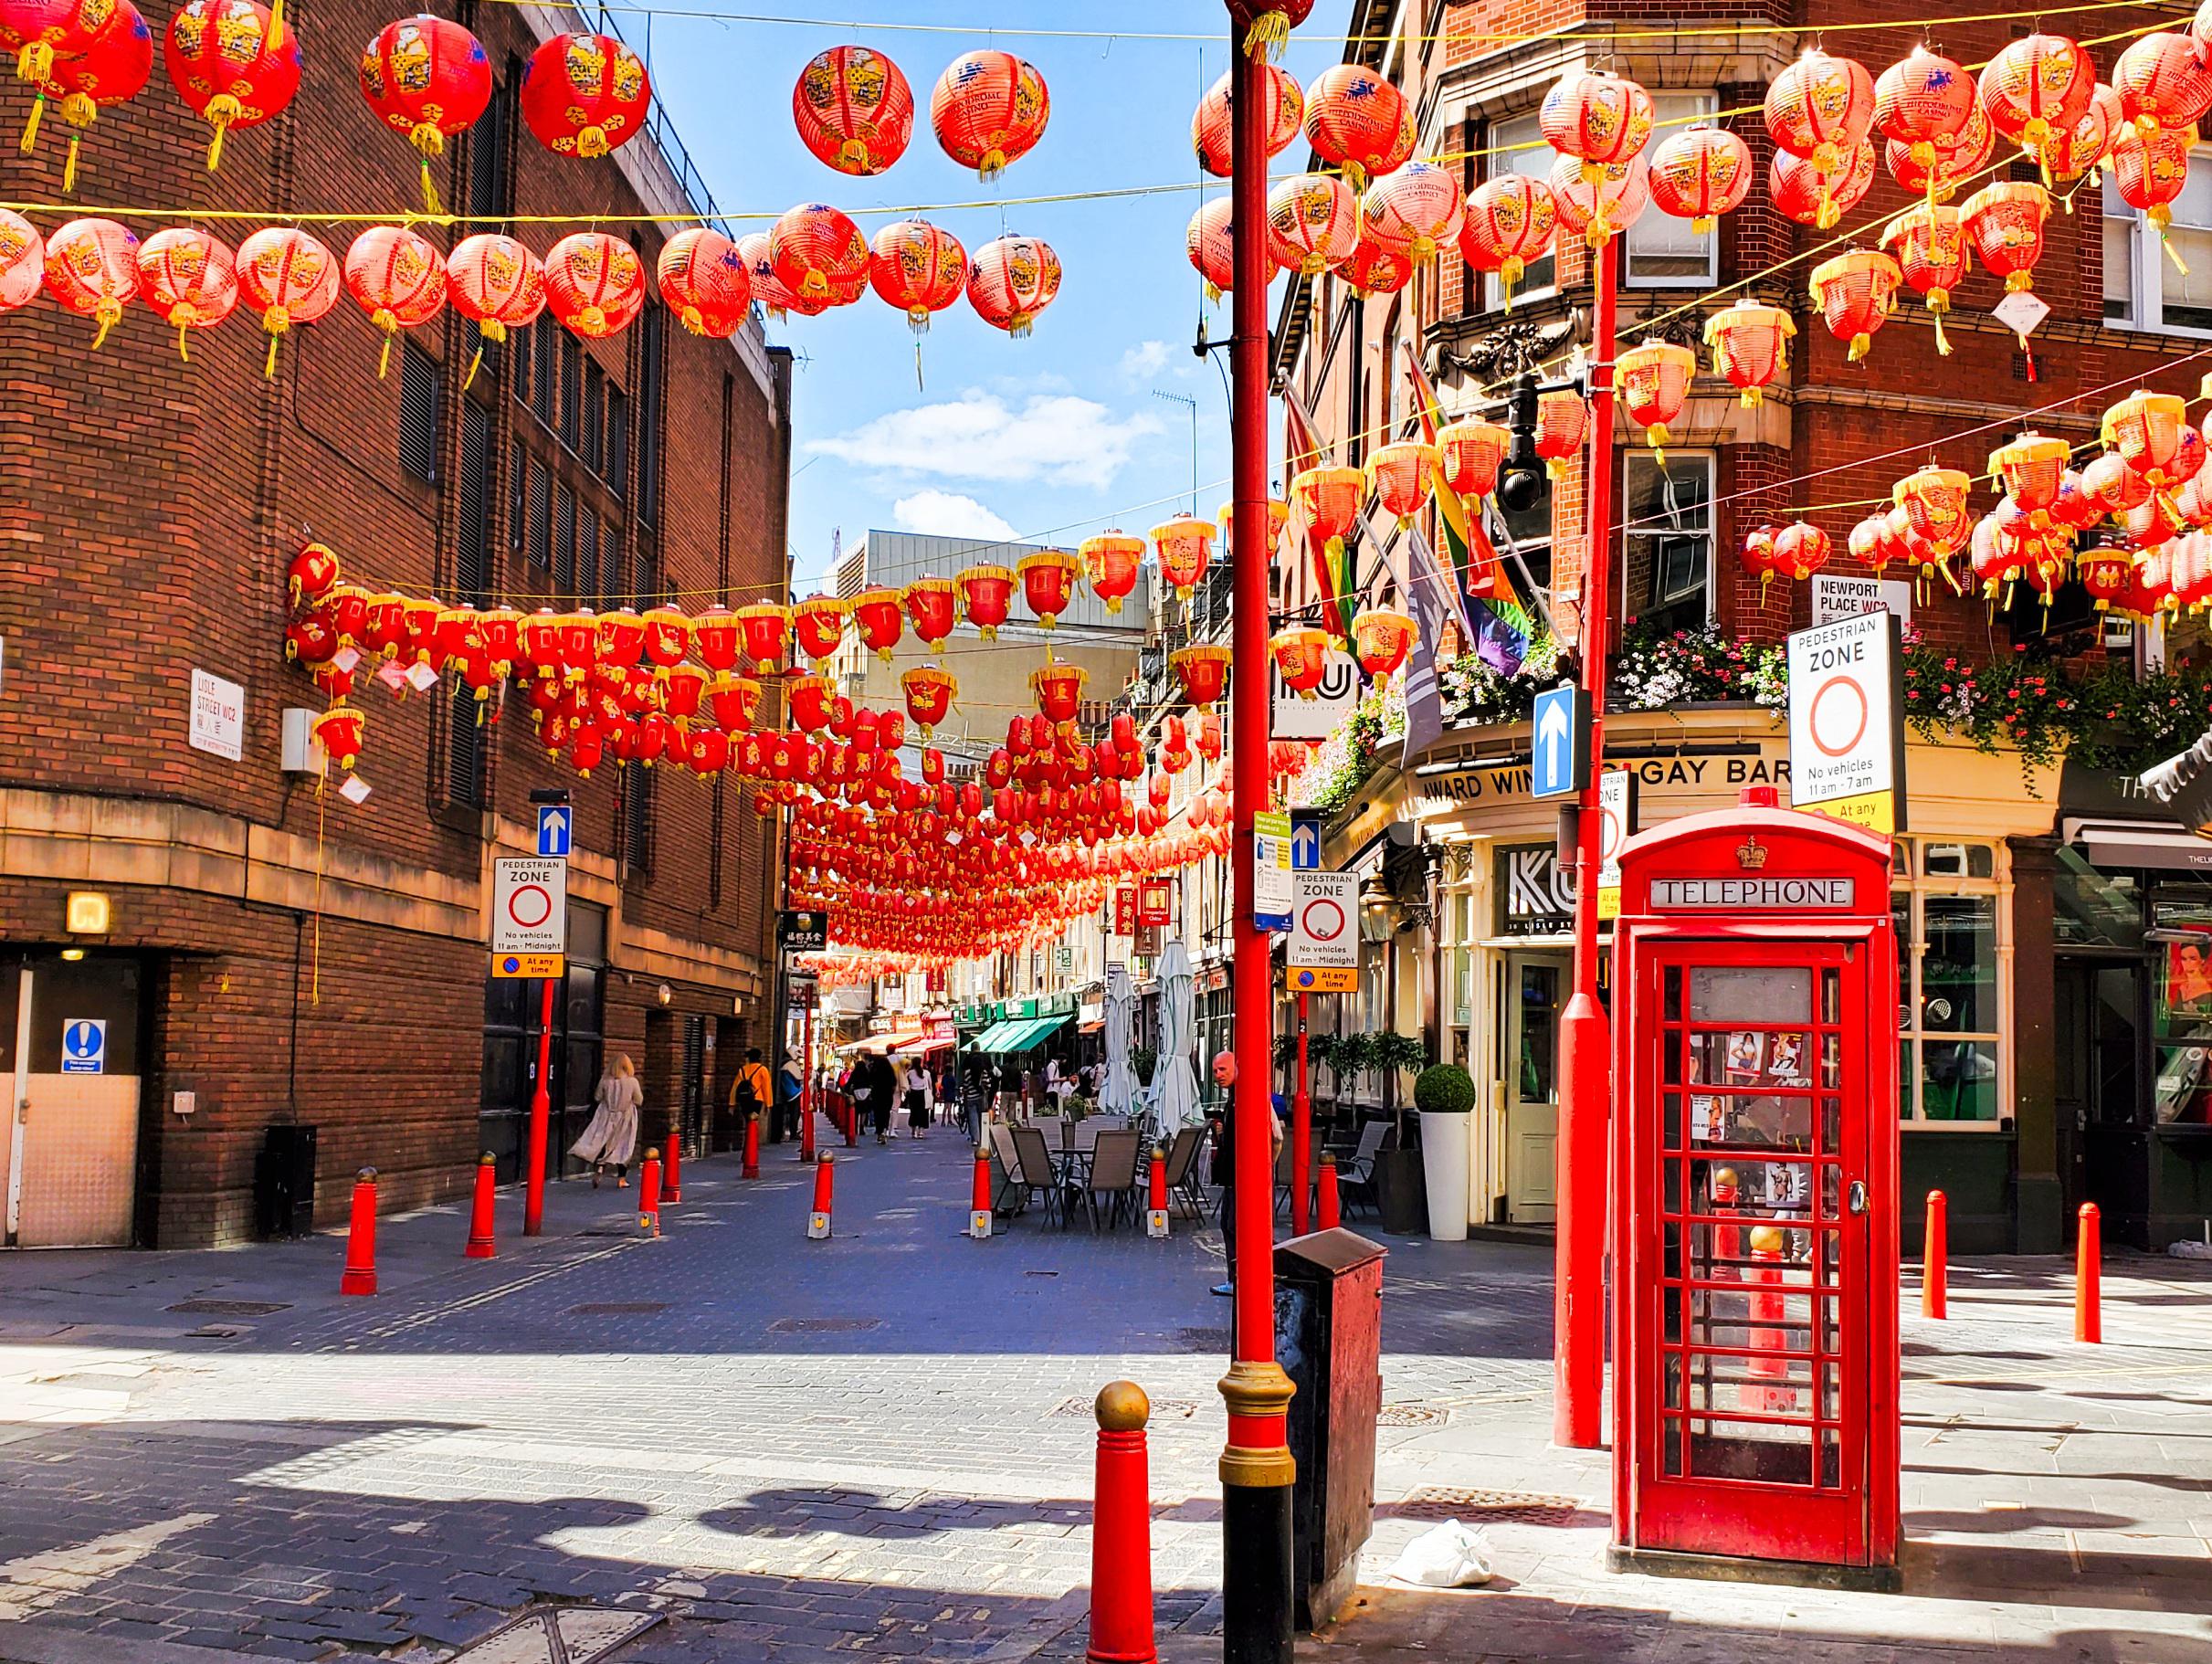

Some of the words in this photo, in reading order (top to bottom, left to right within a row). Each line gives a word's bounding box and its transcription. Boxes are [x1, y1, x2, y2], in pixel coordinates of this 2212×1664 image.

[1821, 581, 1879, 597] NEWPORT
[1821, 596, 1858, 612] PLACE
[1799, 618, 1877, 649] PEDESTRIAN
[1809, 641, 1865, 672] ZONE
[198, 677, 216, 696] LISLE
[197, 695, 221, 716] STREET
[222, 704, 237, 722] WC2
[1808, 766, 1824, 780] No
[1828, 759, 1873, 776] vehicles
[1423, 775, 1482, 802] AWARD
[1640, 760, 1709, 785] GAY
[1727, 760, 1792, 784] BAR
[1840, 806, 1853, 817] At
[1857, 804, 1877, 815] any
[510, 871, 551, 882] ZONE
[1295, 874, 1353, 883] PEDESTRIAN
[1302, 884, 1344, 897] ZONE
[1660, 880, 1847, 904] TELEPHONE
[524, 943, 561, 951] Midnight
[1313, 945, 1347, 953] vehicles
[527, 957, 537, 965] At
[1319, 956, 1355, 965] Midnight
[1325, 980, 1344, 988] time
